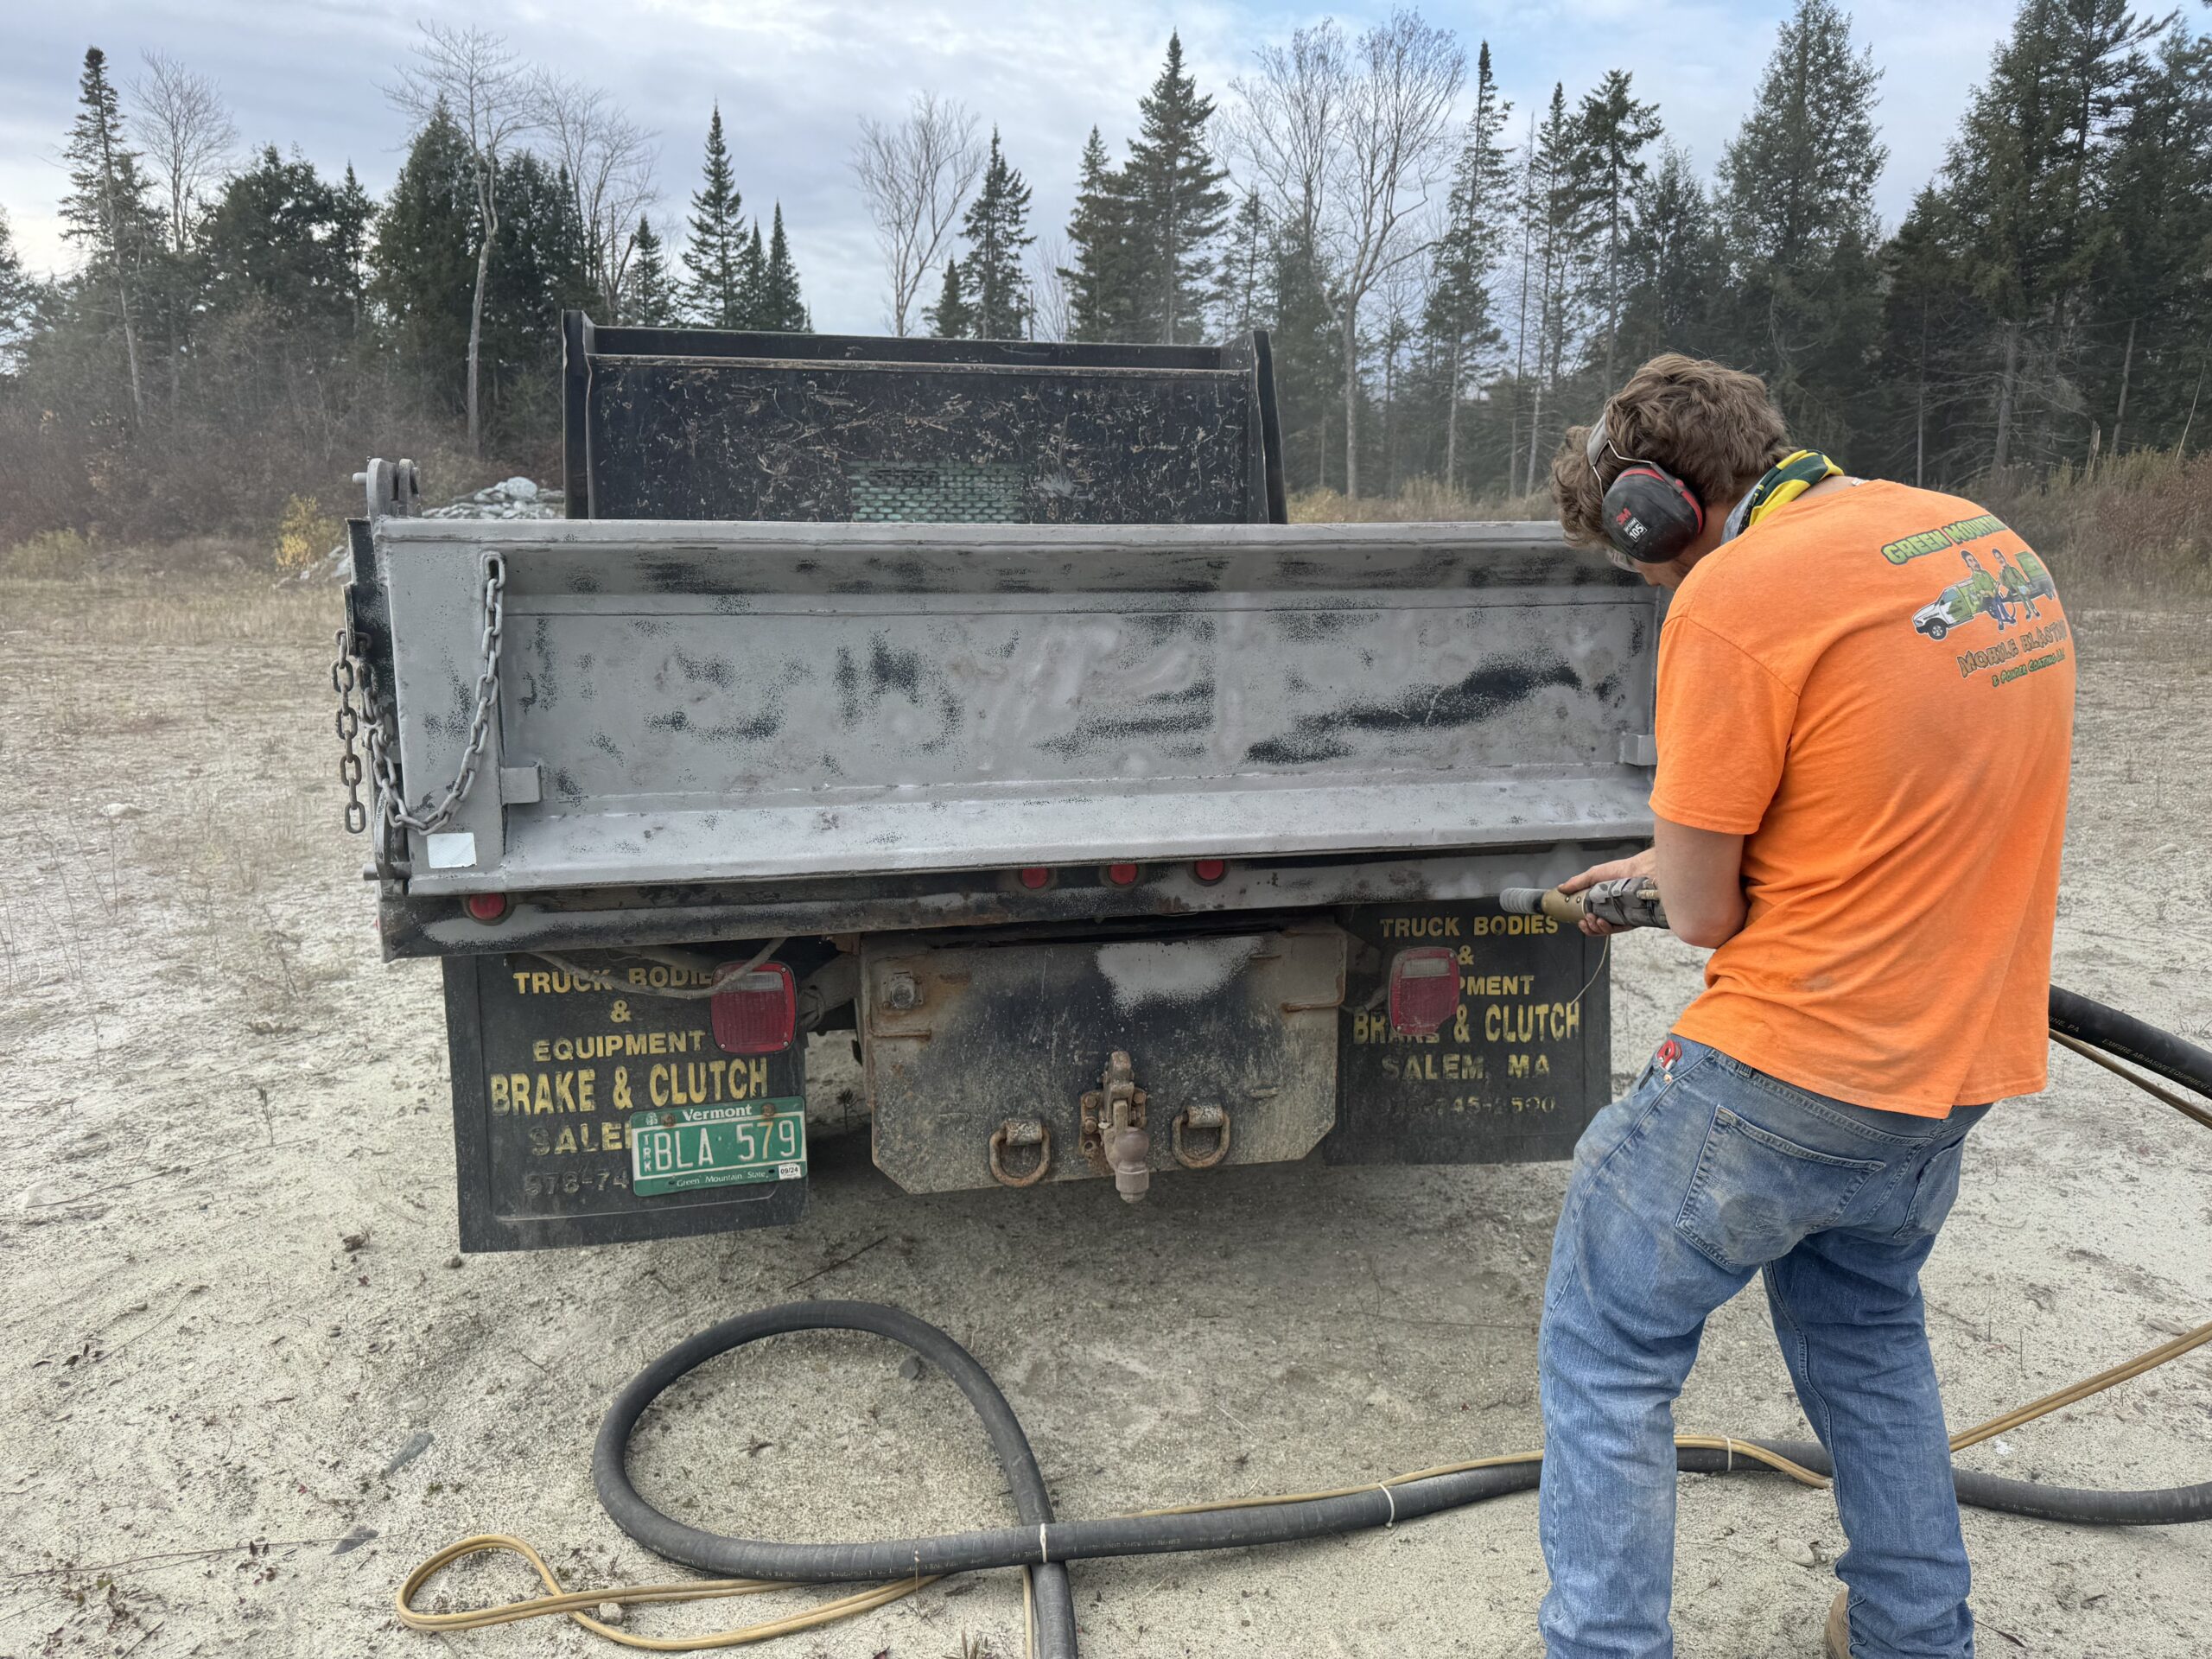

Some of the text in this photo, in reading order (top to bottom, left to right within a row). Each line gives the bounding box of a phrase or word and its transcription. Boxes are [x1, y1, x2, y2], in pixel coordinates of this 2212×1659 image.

[1617, 507, 1631, 525] 3M
[1629, 524, 1644, 539] 105
[1881, 529, 1953, 565] GREEN
[1956, 639, 2018, 678] MOBILE
[1380, 914, 1559, 938] TRUCK BODIES
[1457, 944, 1474, 965] &
[513, 968, 613, 995] TRUCK
[610, 1000, 632, 1023] &
[1453, 1004, 1471, 1043] &
[1484, 1001, 1580, 1043] CLUTCH
[532, 1030, 706, 1062] EQUIPMENT
[1507, 1054, 1551, 1079] MA
[490, 1058, 769, 1116] BRAKE & CLUTCH
[683, 1104, 753, 1122] Vermont
[653, 1119, 797, 1172] BLA 579
[677, 1179, 701, 1188] Green
[705, 1173, 743, 1184] Mountain
[780, 1166, 799, 1175] 09/24
